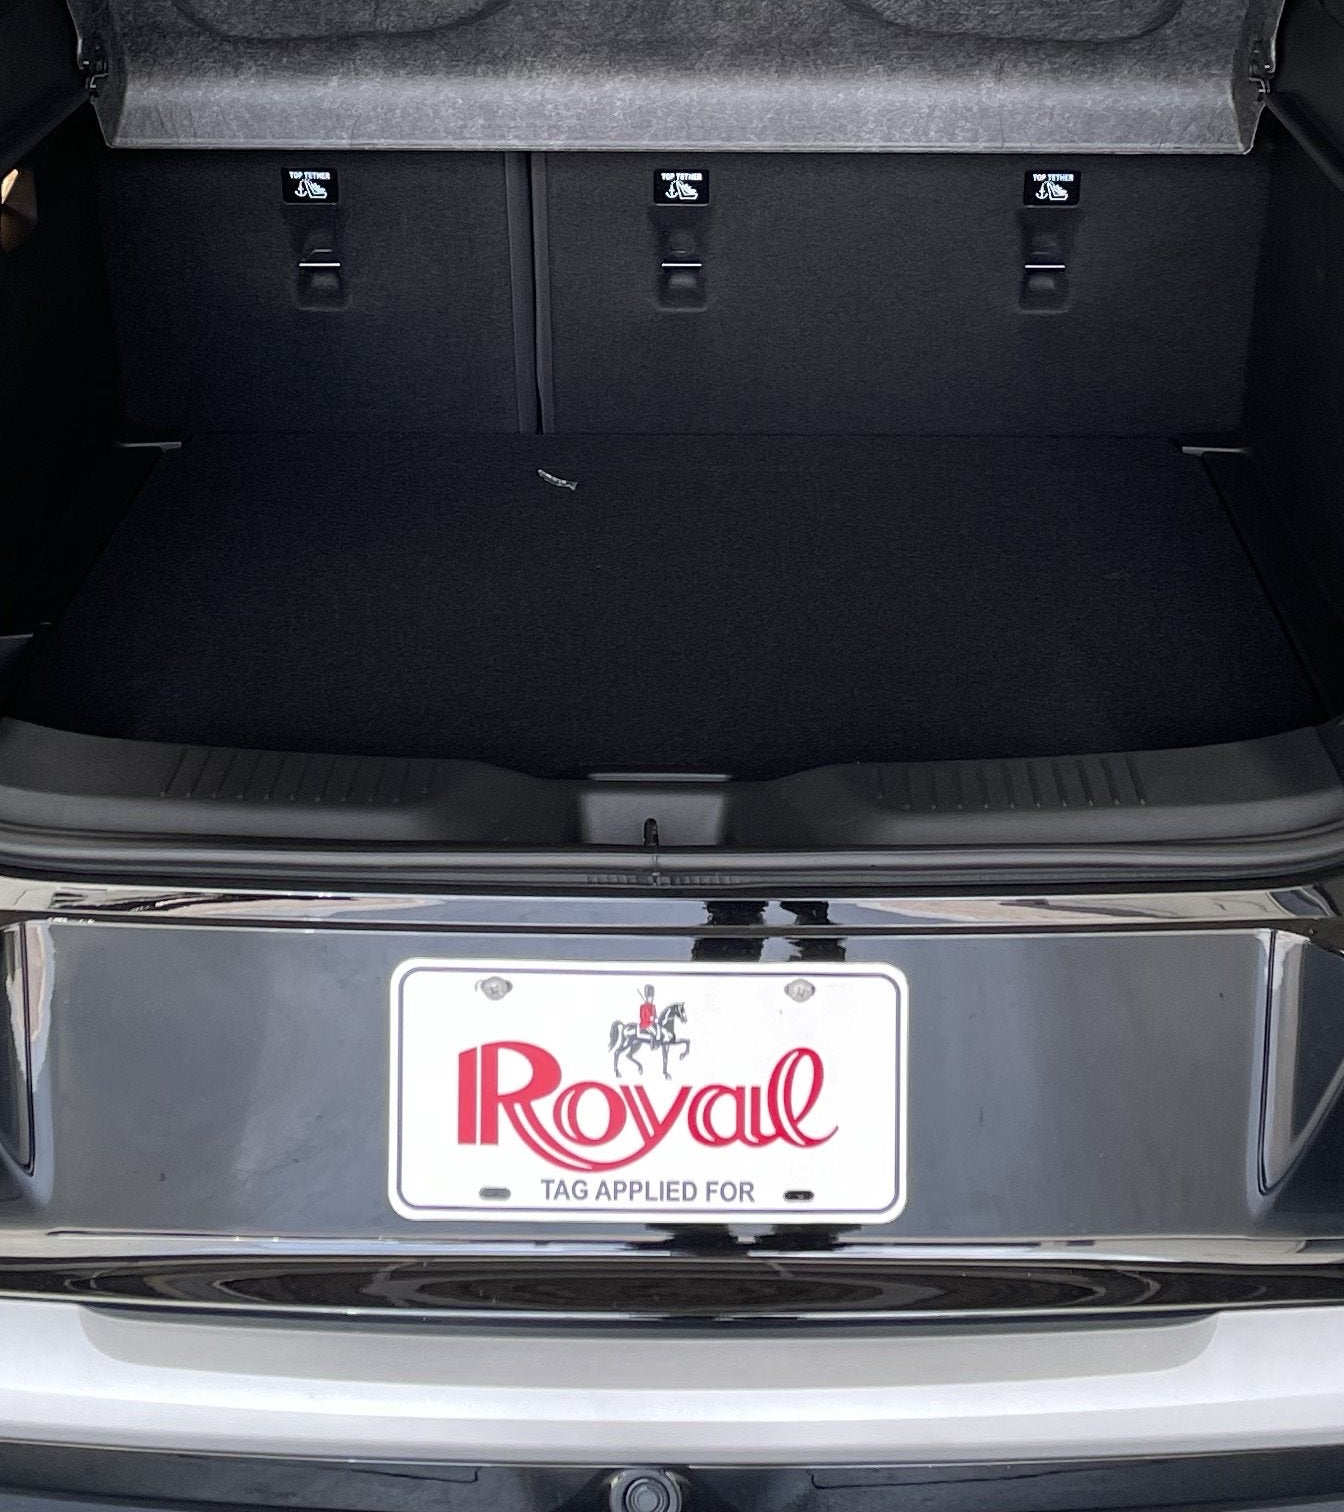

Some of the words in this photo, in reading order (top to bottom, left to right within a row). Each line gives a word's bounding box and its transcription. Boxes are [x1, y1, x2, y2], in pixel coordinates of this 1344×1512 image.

[288, 170, 303, 179] TOP
[304, 171, 331, 180] TETHER
[660, 172, 675, 180] TOP
[676, 172, 703, 180] TETHER
[1032, 173, 1047, 181] TOP
[1047, 173, 1074, 181] TETHER
[457, 1040, 839, 1173] Royal
[540, 1178, 589, 1201] TAG
[594, 1179, 698, 1202] APPLIED
[705, 1180, 755, 1203] FOR
